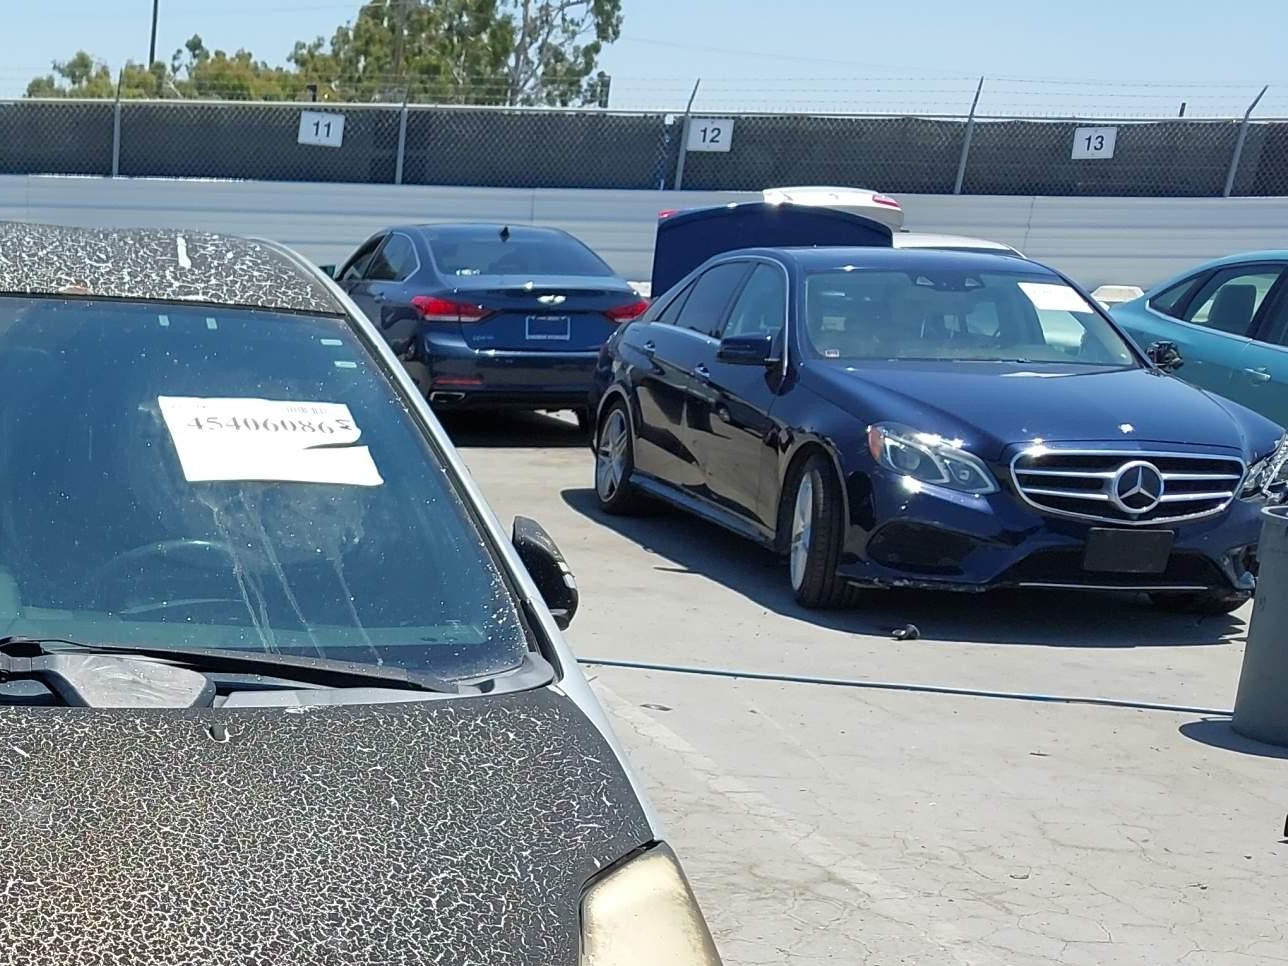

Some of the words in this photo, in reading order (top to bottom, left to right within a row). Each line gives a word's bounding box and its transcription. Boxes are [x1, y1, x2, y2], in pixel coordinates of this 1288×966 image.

[313, 120, 331, 137] 11
[700, 127, 721, 143] 12
[1084, 135, 1105, 151] 13
